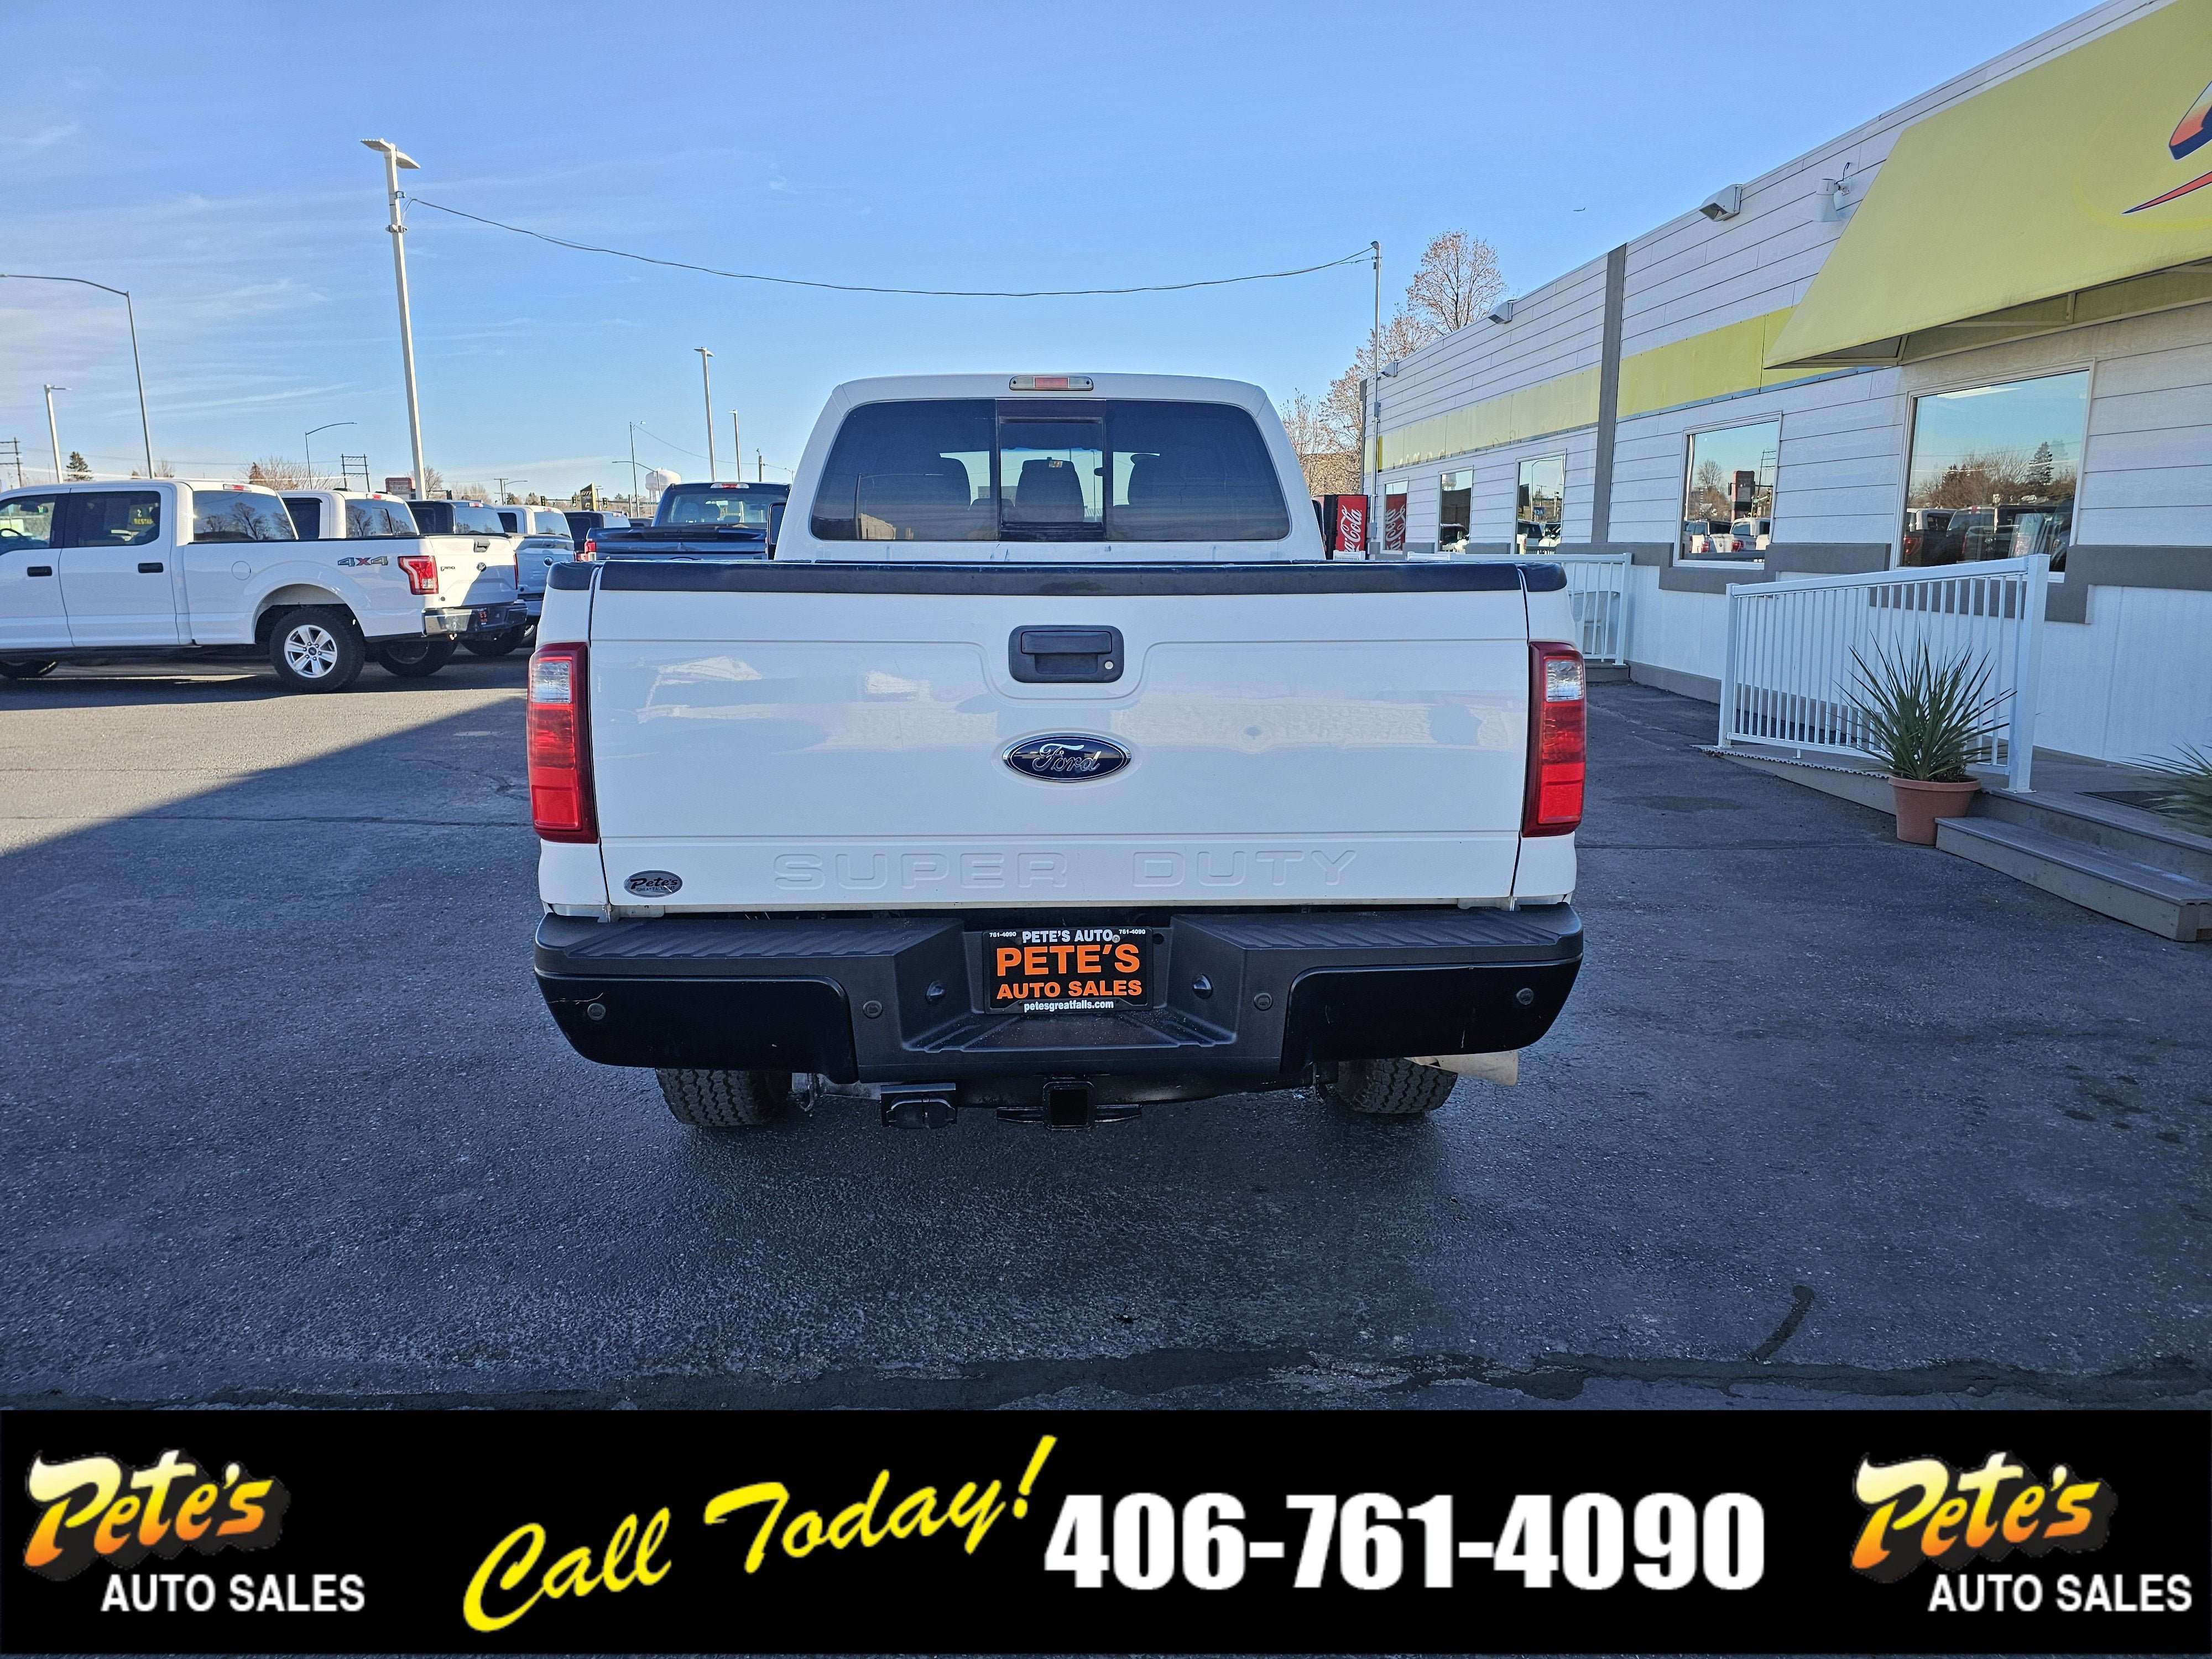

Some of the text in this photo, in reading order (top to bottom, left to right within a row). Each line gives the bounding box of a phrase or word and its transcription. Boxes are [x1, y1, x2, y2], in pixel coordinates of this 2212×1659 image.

[1032, 743, 1102, 772] Ford
[774, 850, 1357, 890] SUPER DUTY
[630, 877, 678, 890] Pete's
[1022, 929, 1113, 943] PETE'S AUTO
[997, 943, 1140, 977] PETE'S
[996, 979, 1142, 999] AUTO SALES
[1024, 999, 1114, 1013] petesgreatfalls.com
